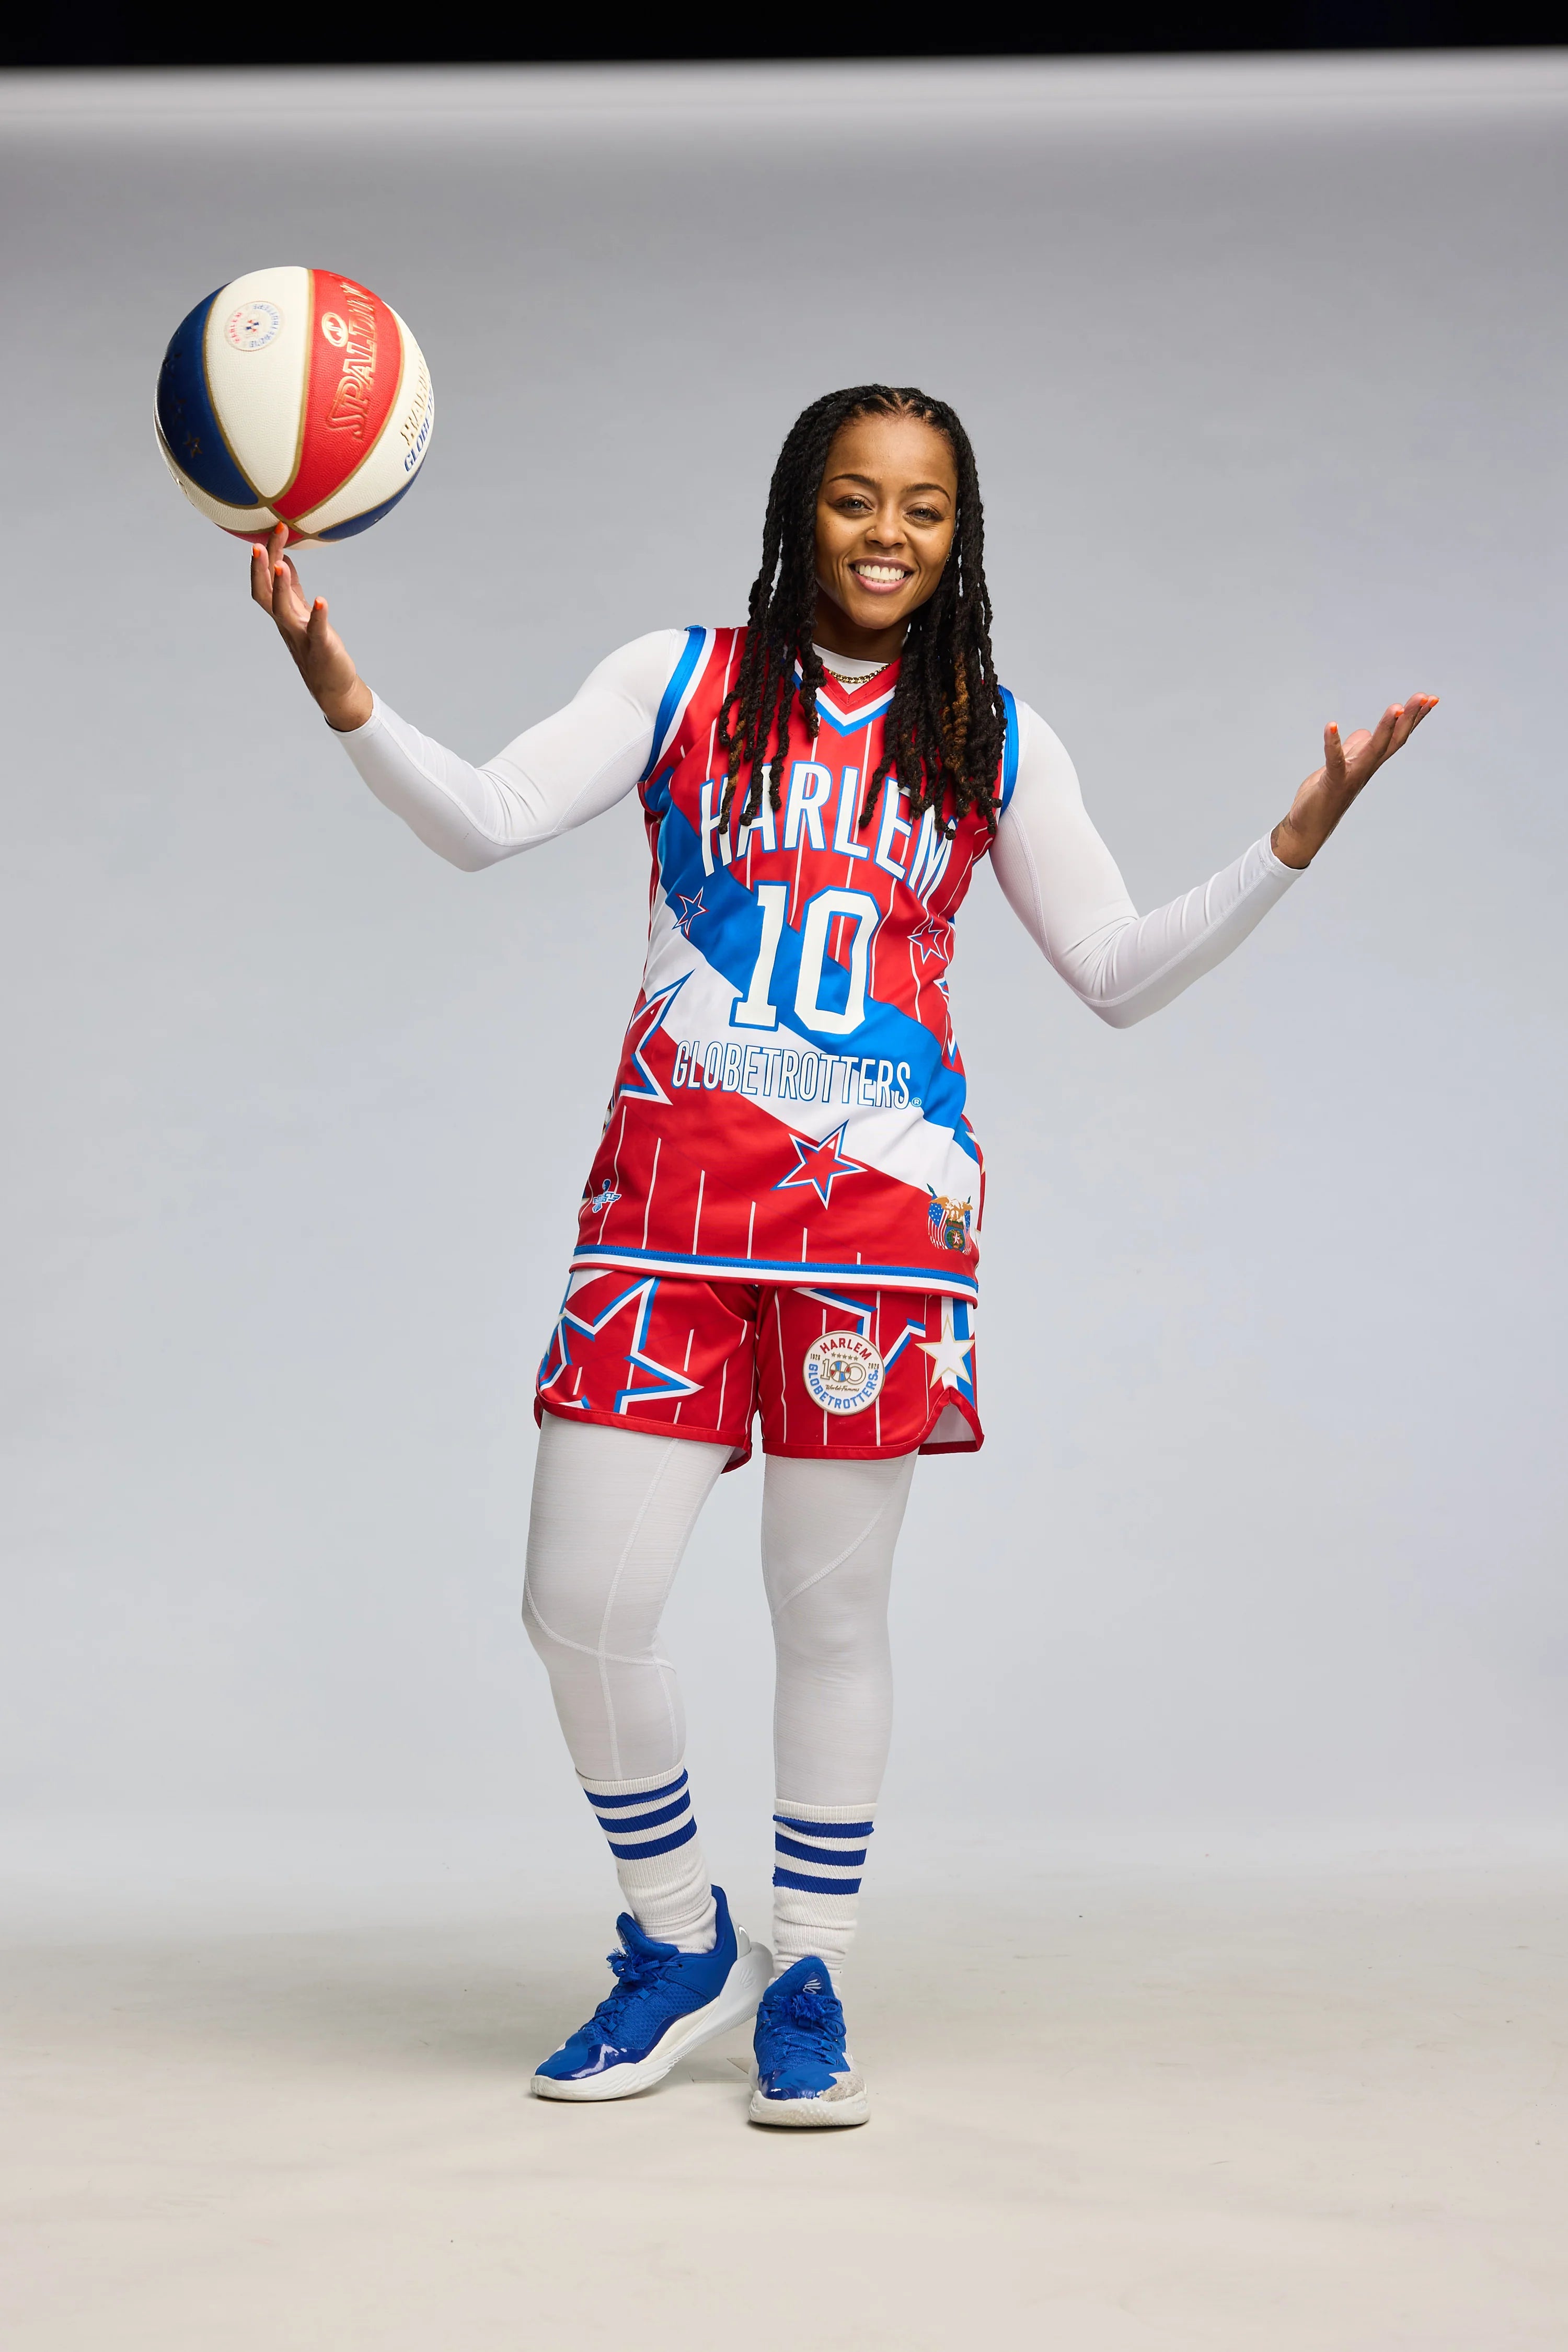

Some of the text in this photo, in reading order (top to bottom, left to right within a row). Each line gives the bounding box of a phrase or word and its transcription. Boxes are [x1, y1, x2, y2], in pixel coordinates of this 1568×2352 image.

[326, 274, 377, 440] SPALDIN
[699, 760, 958, 911] HARLEM
[728, 880, 882, 1035] 10
[820, 1338, 872, 1360] HARLEM
[820, 1358, 867, 1385] 100
